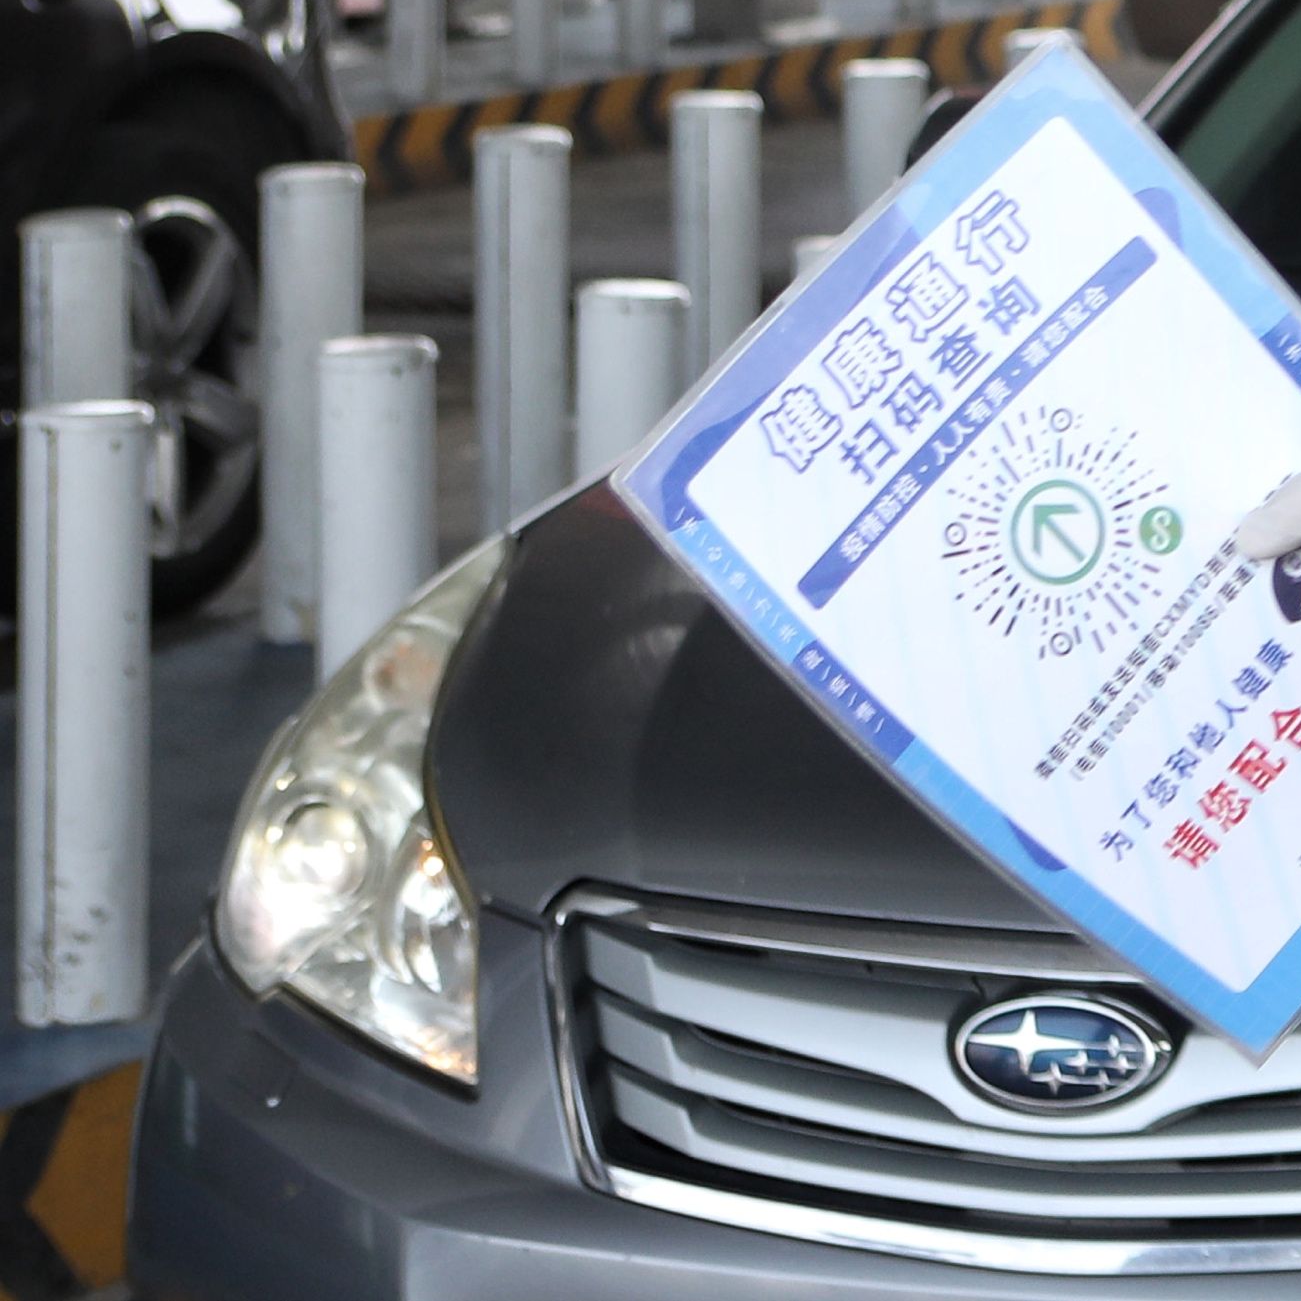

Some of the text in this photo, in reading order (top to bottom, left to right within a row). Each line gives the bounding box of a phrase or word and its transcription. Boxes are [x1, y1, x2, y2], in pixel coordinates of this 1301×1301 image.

[758, 188, 1034, 475] 健康通行
[840, 274, 1042, 485] 扫码查询
[1099, 639, 1294, 863] 为了您和他人健康
